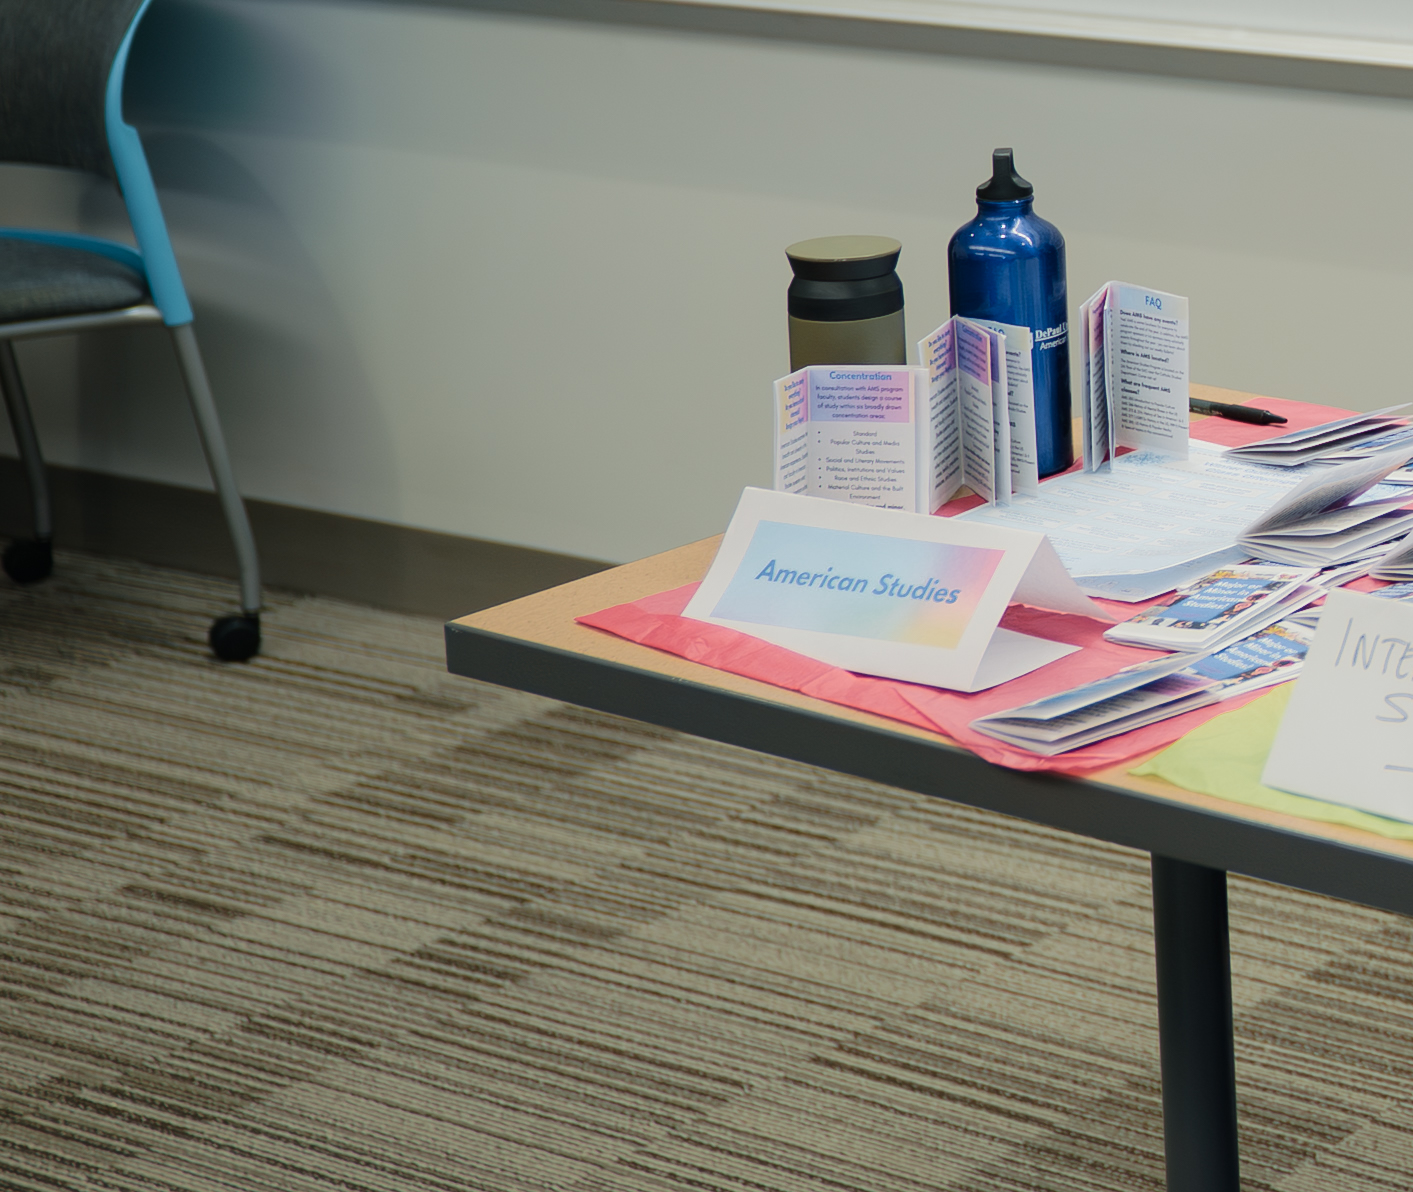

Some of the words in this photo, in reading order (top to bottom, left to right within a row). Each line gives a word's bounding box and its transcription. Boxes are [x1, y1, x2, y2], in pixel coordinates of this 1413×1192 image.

[1145, 295, 1162, 310] FAQ
[1035, 324, 1062, 339] DePaul
[829, 371, 892, 381] Concentration
[754, 559, 869, 593] American
[872, 573, 962, 606] Studies
[1213, 580, 1245, 589] Major
[1203, 587, 1236, 595] Minor
[1190, 595, 1246, 603] American
[1182, 601, 1230, 610] Studies!
